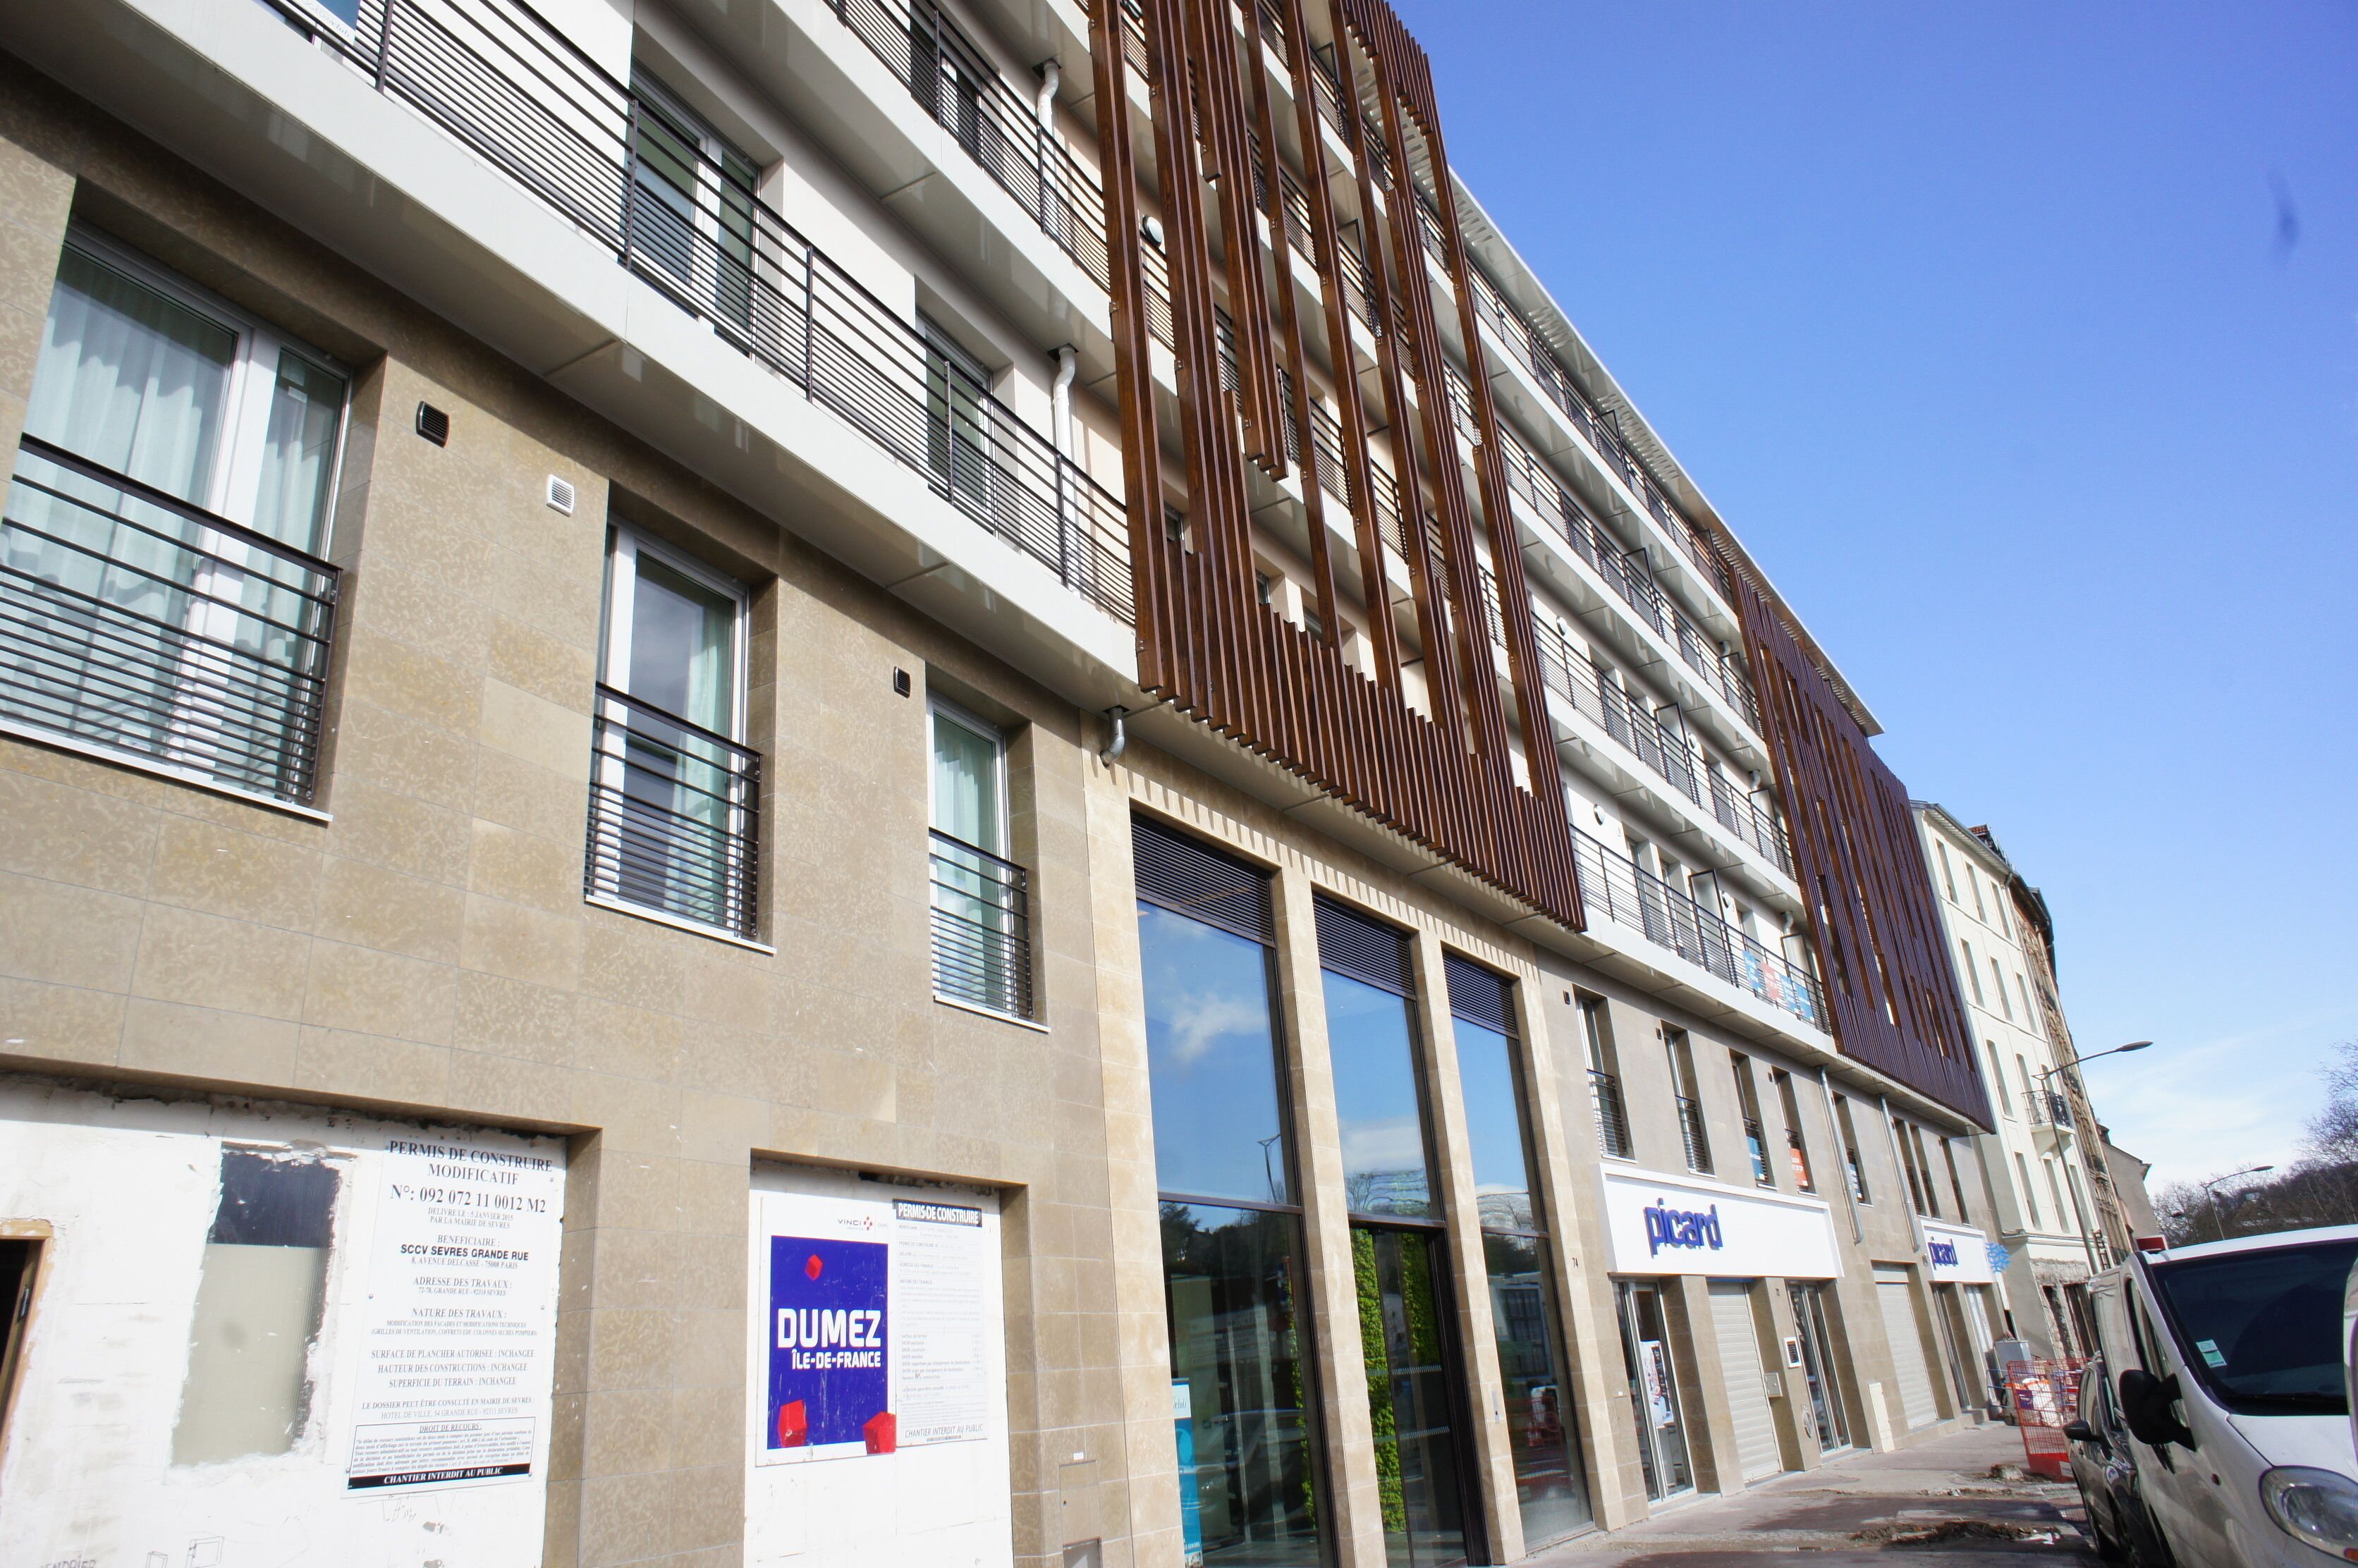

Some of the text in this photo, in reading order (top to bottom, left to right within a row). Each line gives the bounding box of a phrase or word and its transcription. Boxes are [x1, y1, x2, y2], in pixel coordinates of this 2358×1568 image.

[389, 1140, 553, 1172] PERMIS DE CONSTRUIRE
[428, 1163, 520, 1185] MODIFICATIF
[420, 1187, 444, 1203] 092
[448, 1189, 471, 1206] 072
[476, 1192, 489, 1208] 11
[494, 1194, 523, 1211] 0012
[526, 1198, 546, 1213] M2
[898, 1203, 979, 1224] PERMIS DE CONSTRUIRE
[837, 1218, 862, 1227] VINCI
[1643, 1198, 1723, 1257] picard
[401, 1244, 529, 1261] SCCV SEVRES GRANDE RUE
[1928, 1236, 1958, 1270] picard
[1572, 1258, 1578, 1268] 74
[413, 1276, 451, 1286] ADRESSE
[453, 1278, 469, 1287] DES
[412, 1307, 503, 1319] NATURE DES TRAVAUX
[778, 1308, 881, 1348] DUMEZ
[371, 1349, 405, 1359] SURFACE
[407, 1349, 416, 1358] DE
[417, 1349, 455, 1358] PLANCHER
[792, 1348, 881, 1370] ÎLE-DE-FRANCE
[378, 1364, 413, 1373] HAUTEUR
[415, 1364, 428, 1373] DES
[429, 1364, 486, 1373] CONSTRUCTIONS
[389, 1378, 432, 1388] SUPERFICIE
[444, 1378, 474, 1387] TERRAIN
[372, 1401, 401, 1409] DOSSIER
[402, 1400, 419, 1409] PEUT
[419, 1424, 439, 1433] DROIT
[451, 1423, 479, 1432] RECOURS
[905, 1427, 931, 1438] CHANTIER
[932, 1426, 955, 1435] INTERDIT
[957, 1425, 964, 1433] AU
[965, 1423, 983, 1433] PUBLIC
[384, 1466, 503, 1484] CHANTIER INTERDIT AU PUBLIC
